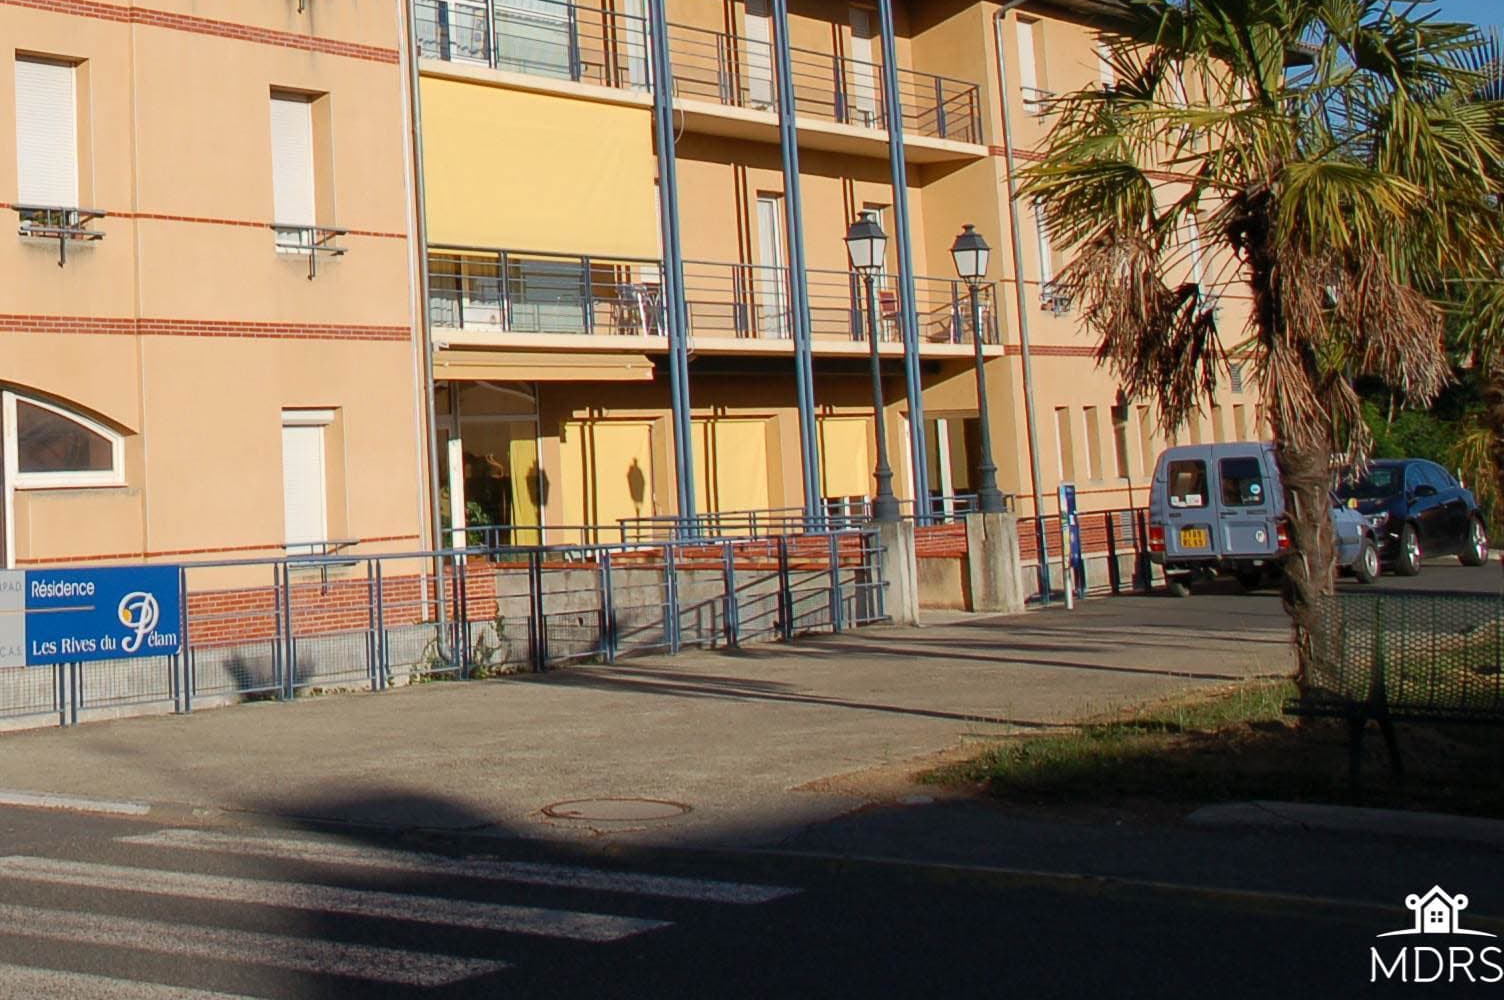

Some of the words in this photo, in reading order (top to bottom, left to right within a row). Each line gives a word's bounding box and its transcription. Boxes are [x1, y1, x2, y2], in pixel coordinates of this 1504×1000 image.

[31, 580, 95, 598] Résidence
[32, 639, 57, 656] Les
[61, 637, 96, 654] Rives
[100, 634, 117, 650] du
[118, 591, 177, 652] Pélam
